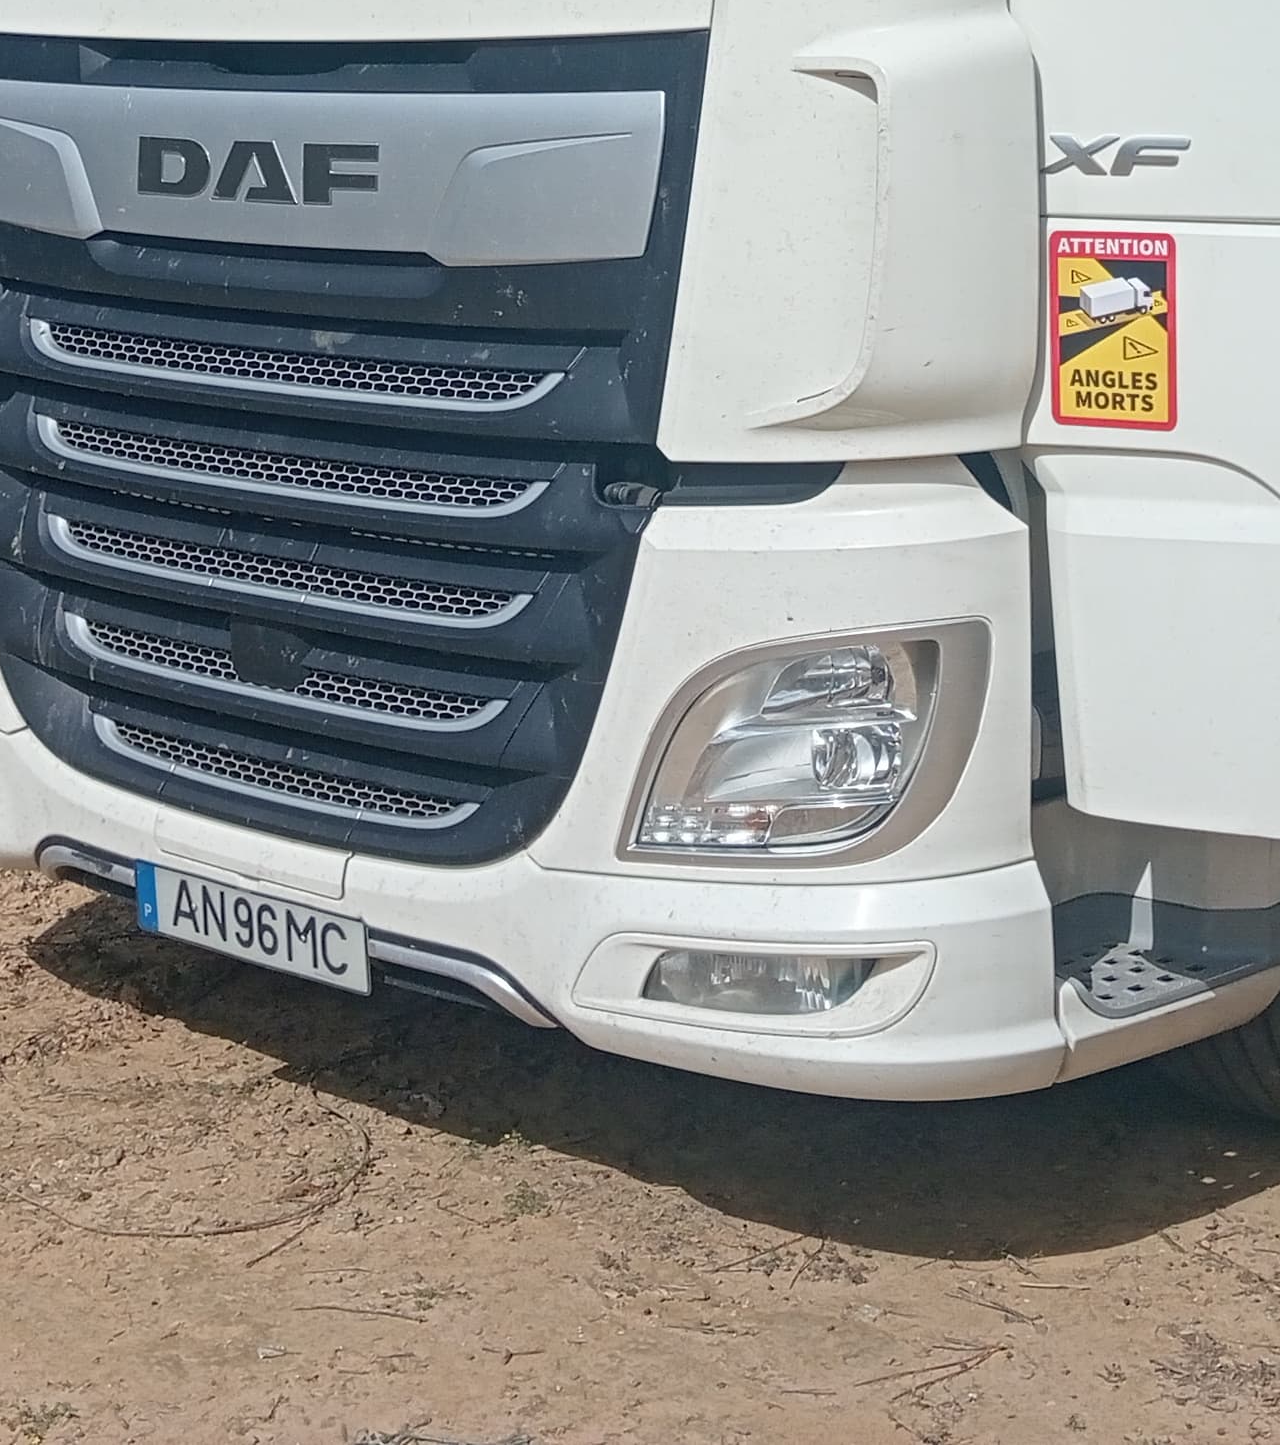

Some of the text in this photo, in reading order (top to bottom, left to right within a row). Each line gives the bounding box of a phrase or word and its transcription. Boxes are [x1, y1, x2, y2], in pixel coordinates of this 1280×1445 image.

[1044, 134, 1191, 177] XF
[136, 135, 380, 206] DAF
[1057, 238, 1168, 256] ATTENTION
[1070, 369, 1158, 391] ANGLES
[1075, 390, 1154, 412] MORTS
[143, 902, 153, 917] P
